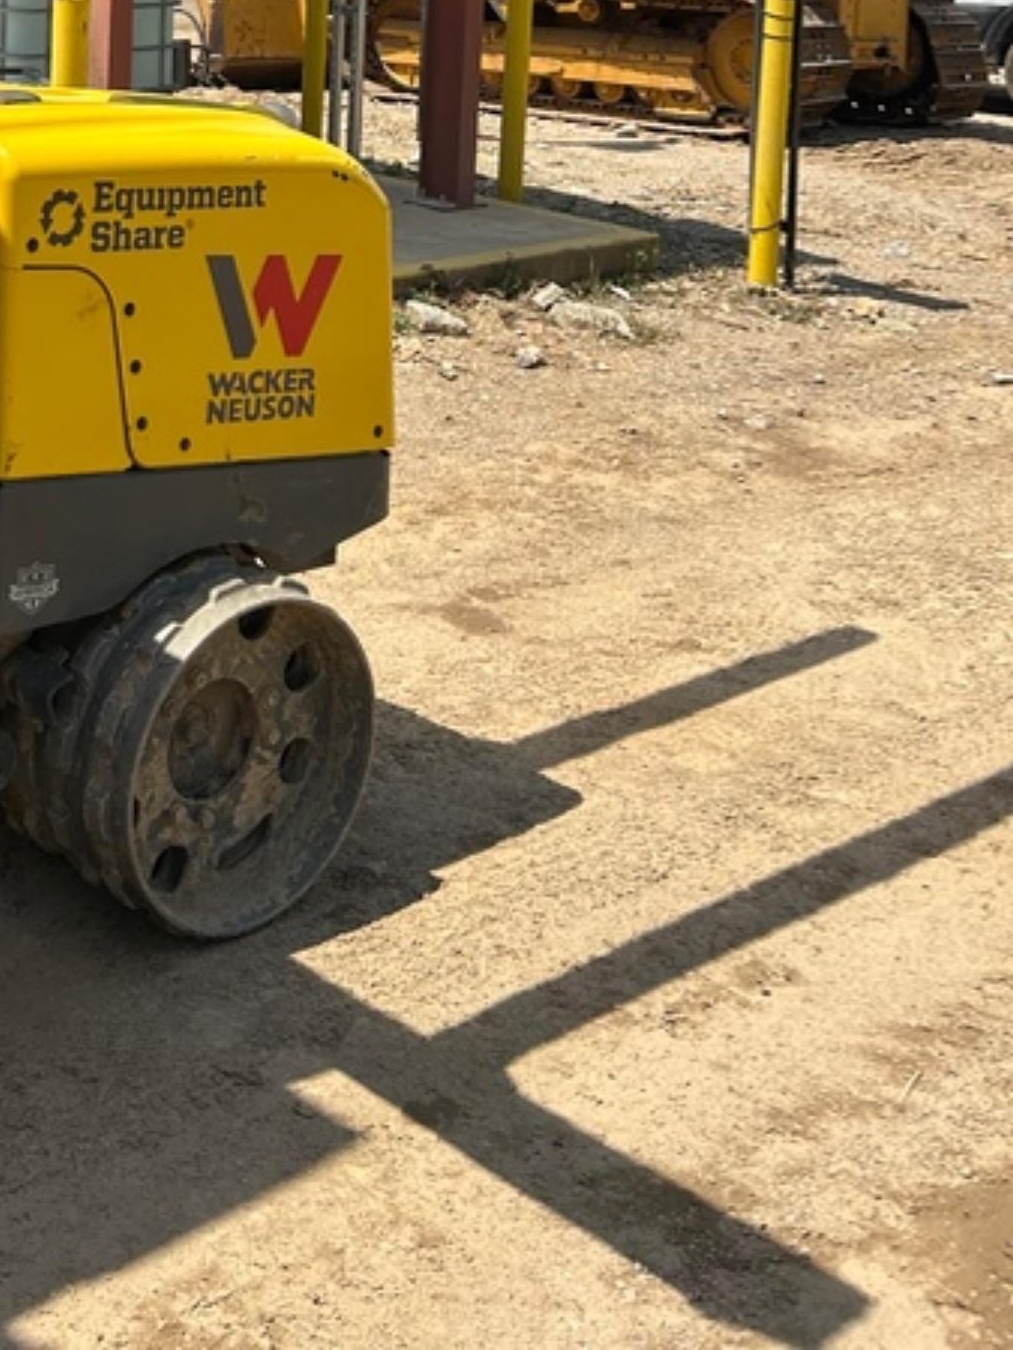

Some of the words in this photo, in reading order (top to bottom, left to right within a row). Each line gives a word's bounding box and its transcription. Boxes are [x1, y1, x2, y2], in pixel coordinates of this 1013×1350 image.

[92, 180, 266, 218] Equipment
[91, 221, 186, 252] Share
[207, 368, 316, 397] WACKER
[205, 394, 315, 425] NEUSON
